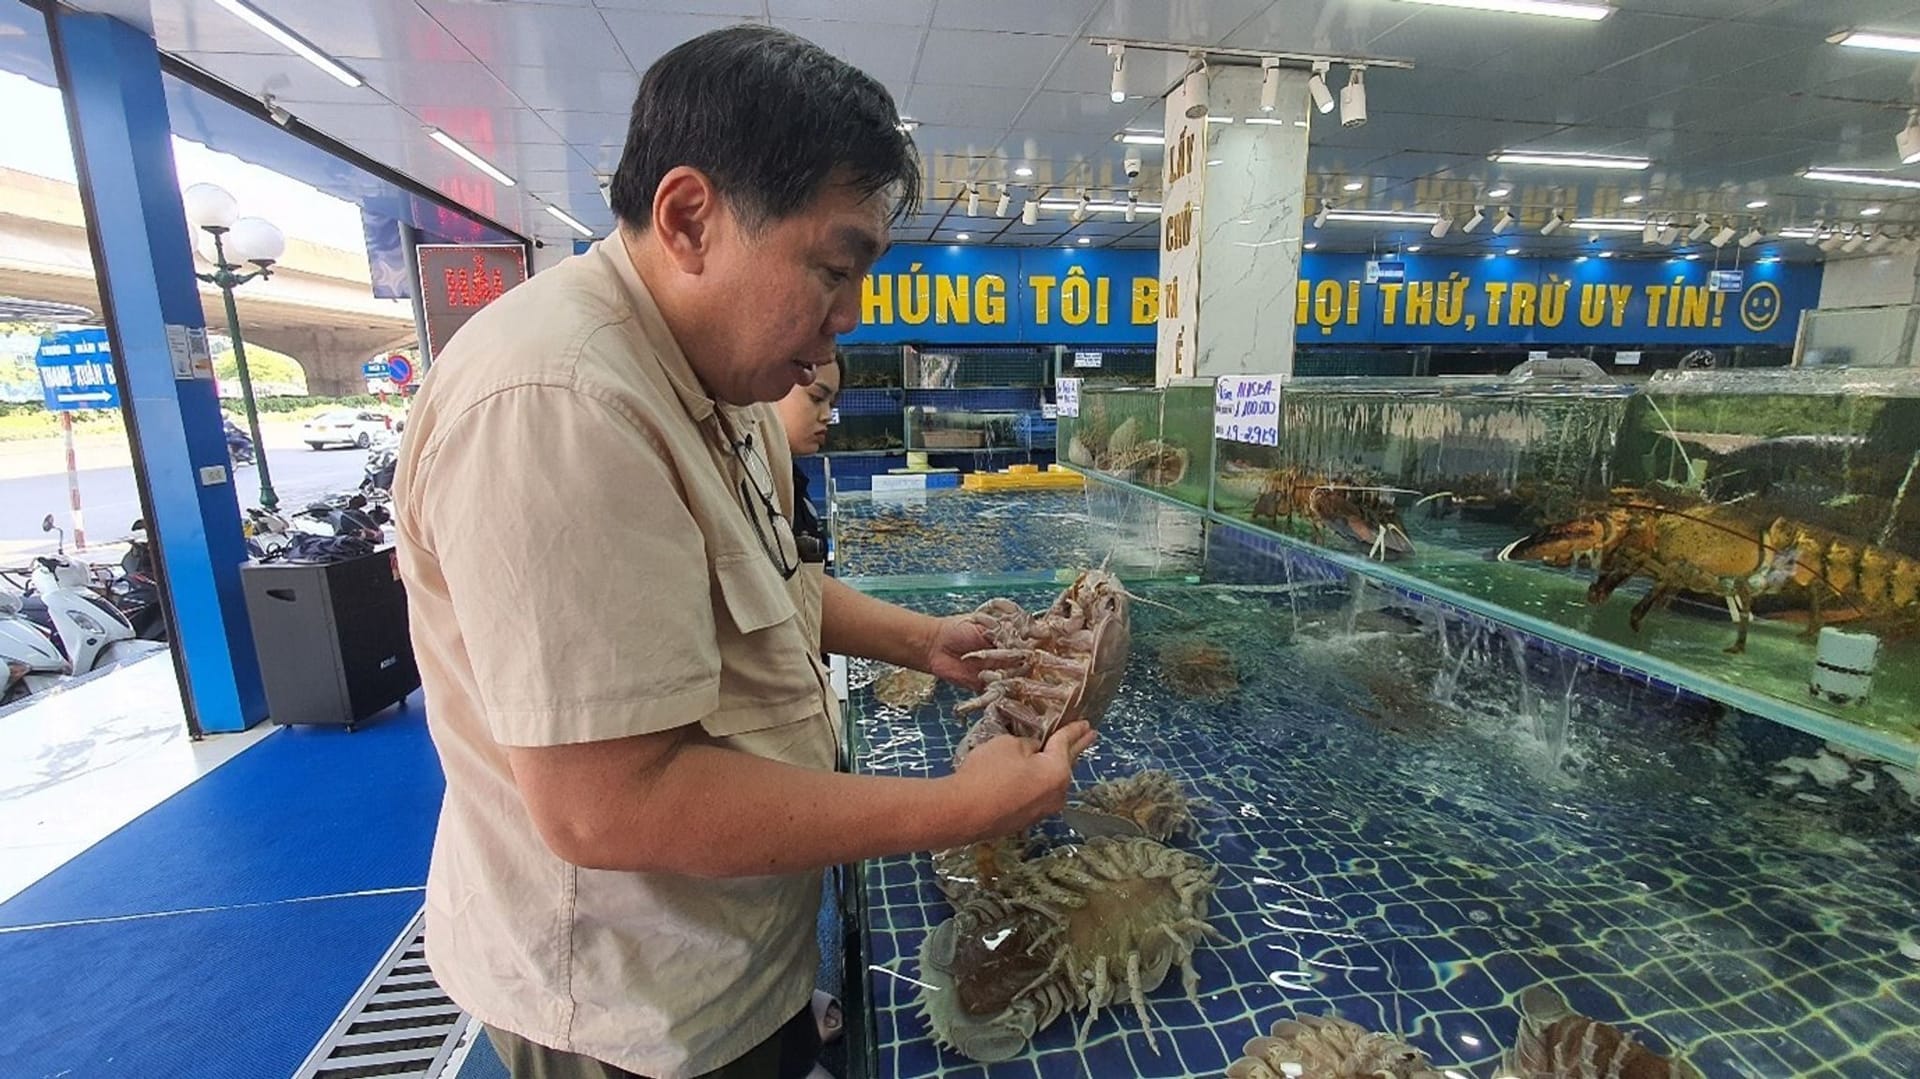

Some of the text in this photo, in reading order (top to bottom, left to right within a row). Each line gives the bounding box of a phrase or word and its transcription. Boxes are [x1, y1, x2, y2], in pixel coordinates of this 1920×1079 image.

[861, 263, 1006, 324] HÚNG
[1029, 266, 1109, 324] TÔI
[1379, 271, 1476, 331] THỨ,
[1485, 273, 1572, 327] TRỪ
[1579, 284, 1633, 327] UY
[1646, 275, 1726, 327] TÍN!
